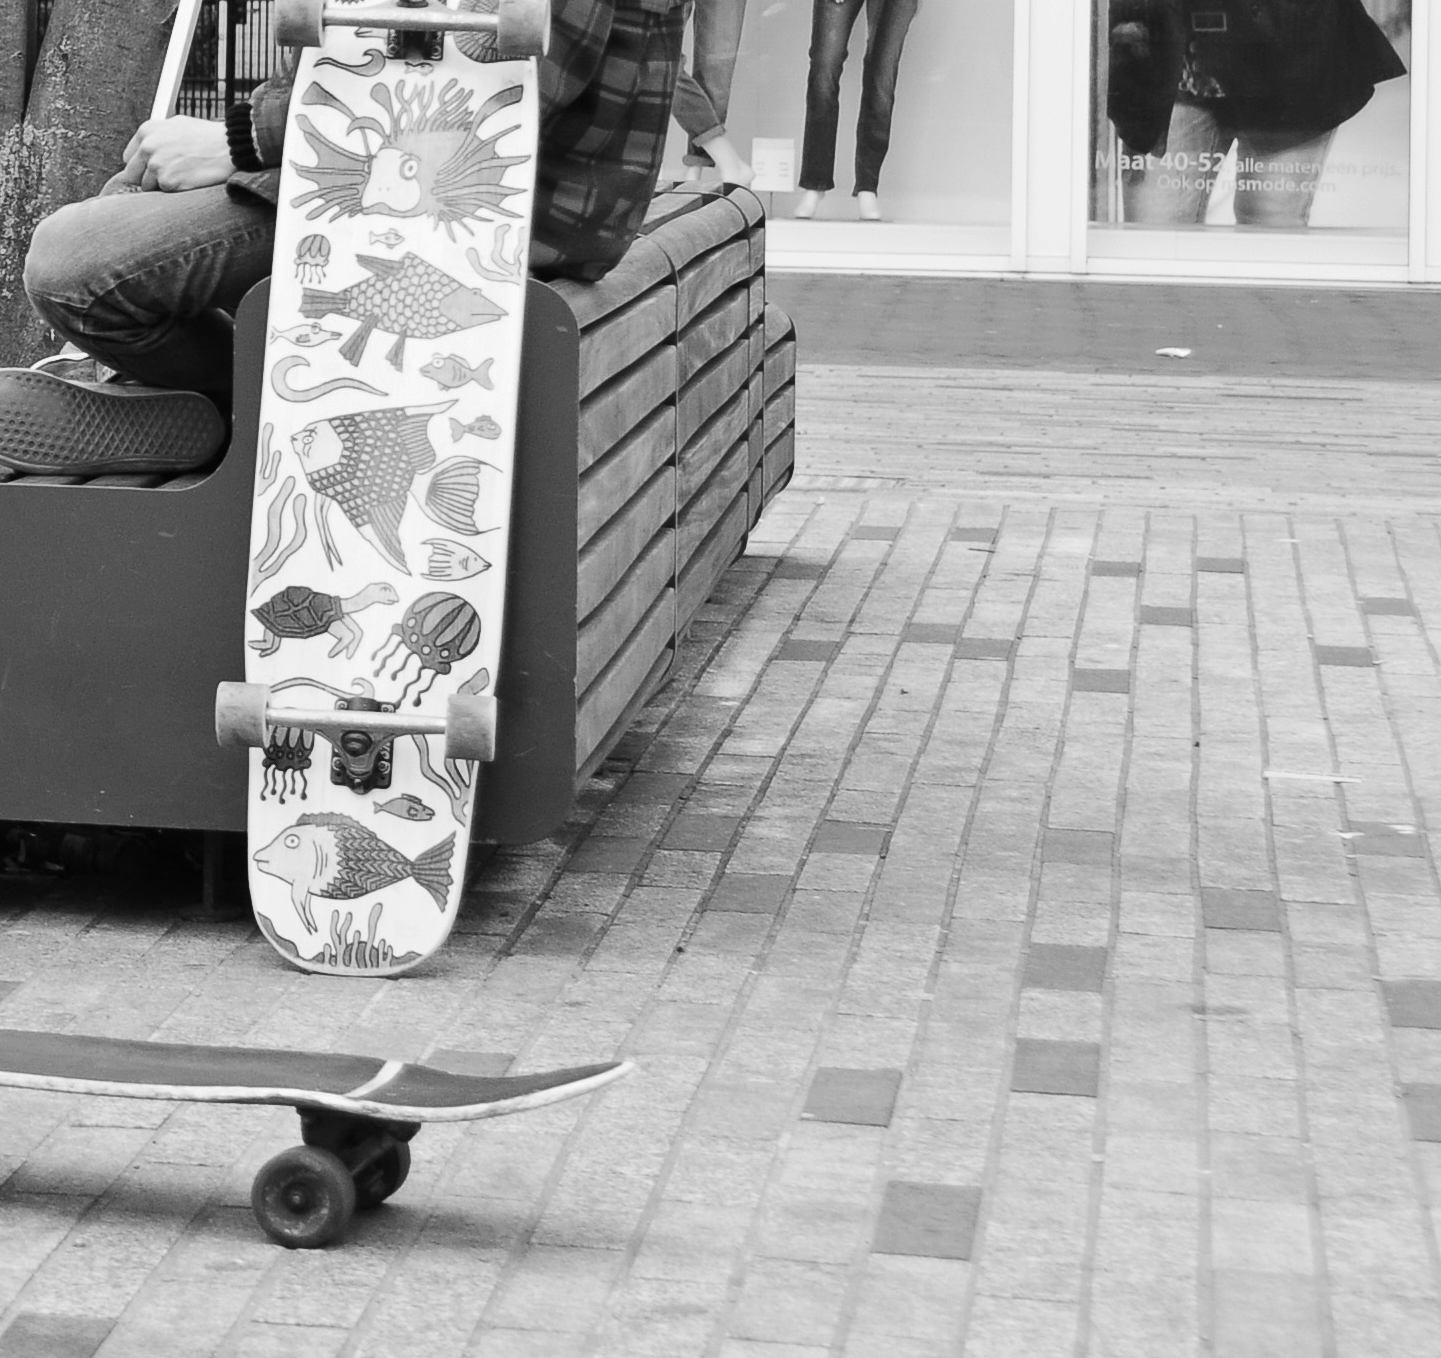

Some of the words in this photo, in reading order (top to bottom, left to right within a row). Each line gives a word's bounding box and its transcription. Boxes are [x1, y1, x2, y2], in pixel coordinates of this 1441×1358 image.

[1095, 150, 1155, 171] Maat
[1236, 157, 1264, 173] alle
[1267, 160, 1323, 175] maten
[1158, 174, 1191, 190] Ook
[1194, 178, 1215, 194] op
